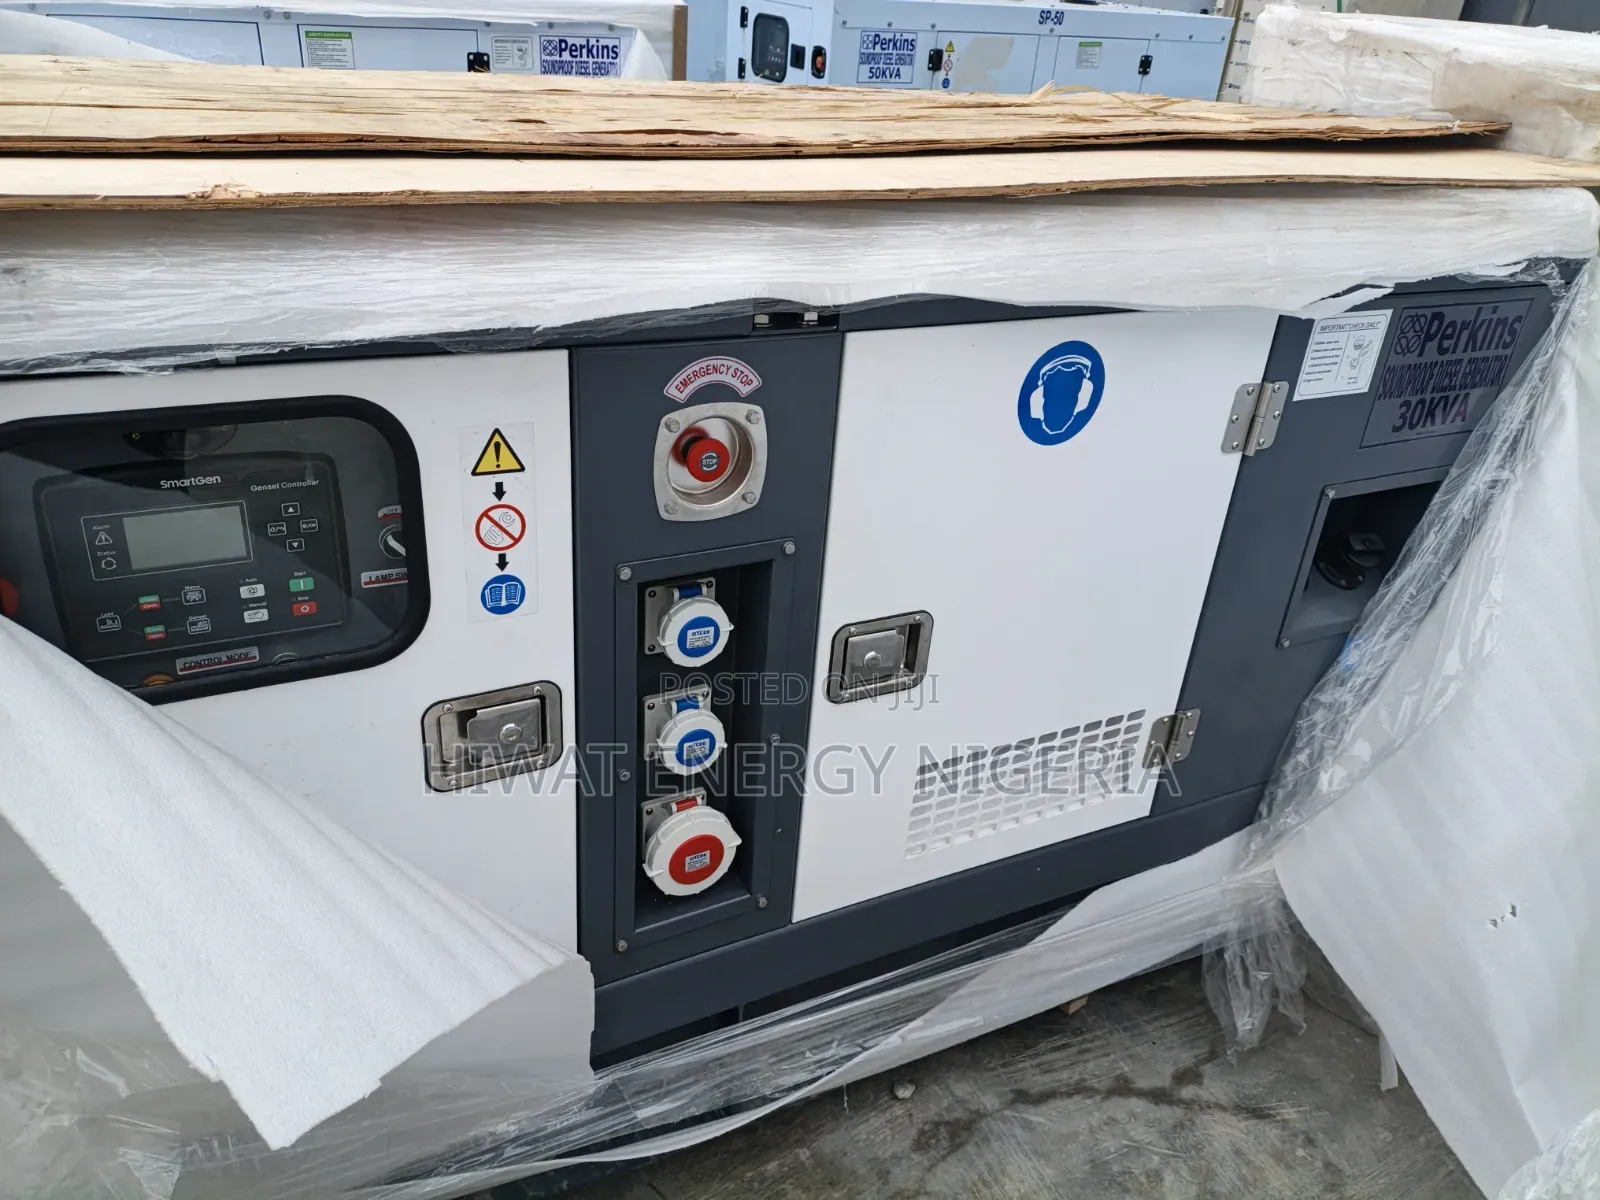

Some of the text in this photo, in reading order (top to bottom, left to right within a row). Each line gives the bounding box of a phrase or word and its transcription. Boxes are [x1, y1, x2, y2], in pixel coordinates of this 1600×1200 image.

[1038, 10, 1065, 26] SP-50
[558, 38, 619, 60] Perkins
[872, 33, 916, 52] Perkins
[541, 59, 574, 75] SOUNDPROOF
[574, 60, 591, 76] DIESEL
[868, 66, 902, 80] 50KVA
[1417, 305, 1524, 358] Perkins
[674, 363, 754, 394] EMERGENCY STOP
[1377, 360, 1439, 401] SOUNDPROOF
[1431, 358, 1465, 394] DIESEL
[1391, 392, 1471, 433] 30KVA
[702, 458, 718, 466] STOP
[160, 475, 222, 489] SmartGen
[250, 479, 320, 492] Genset Controller
[368, 573, 394, 582] LAMP
[183, 651, 252, 669] CONTROL MODE
